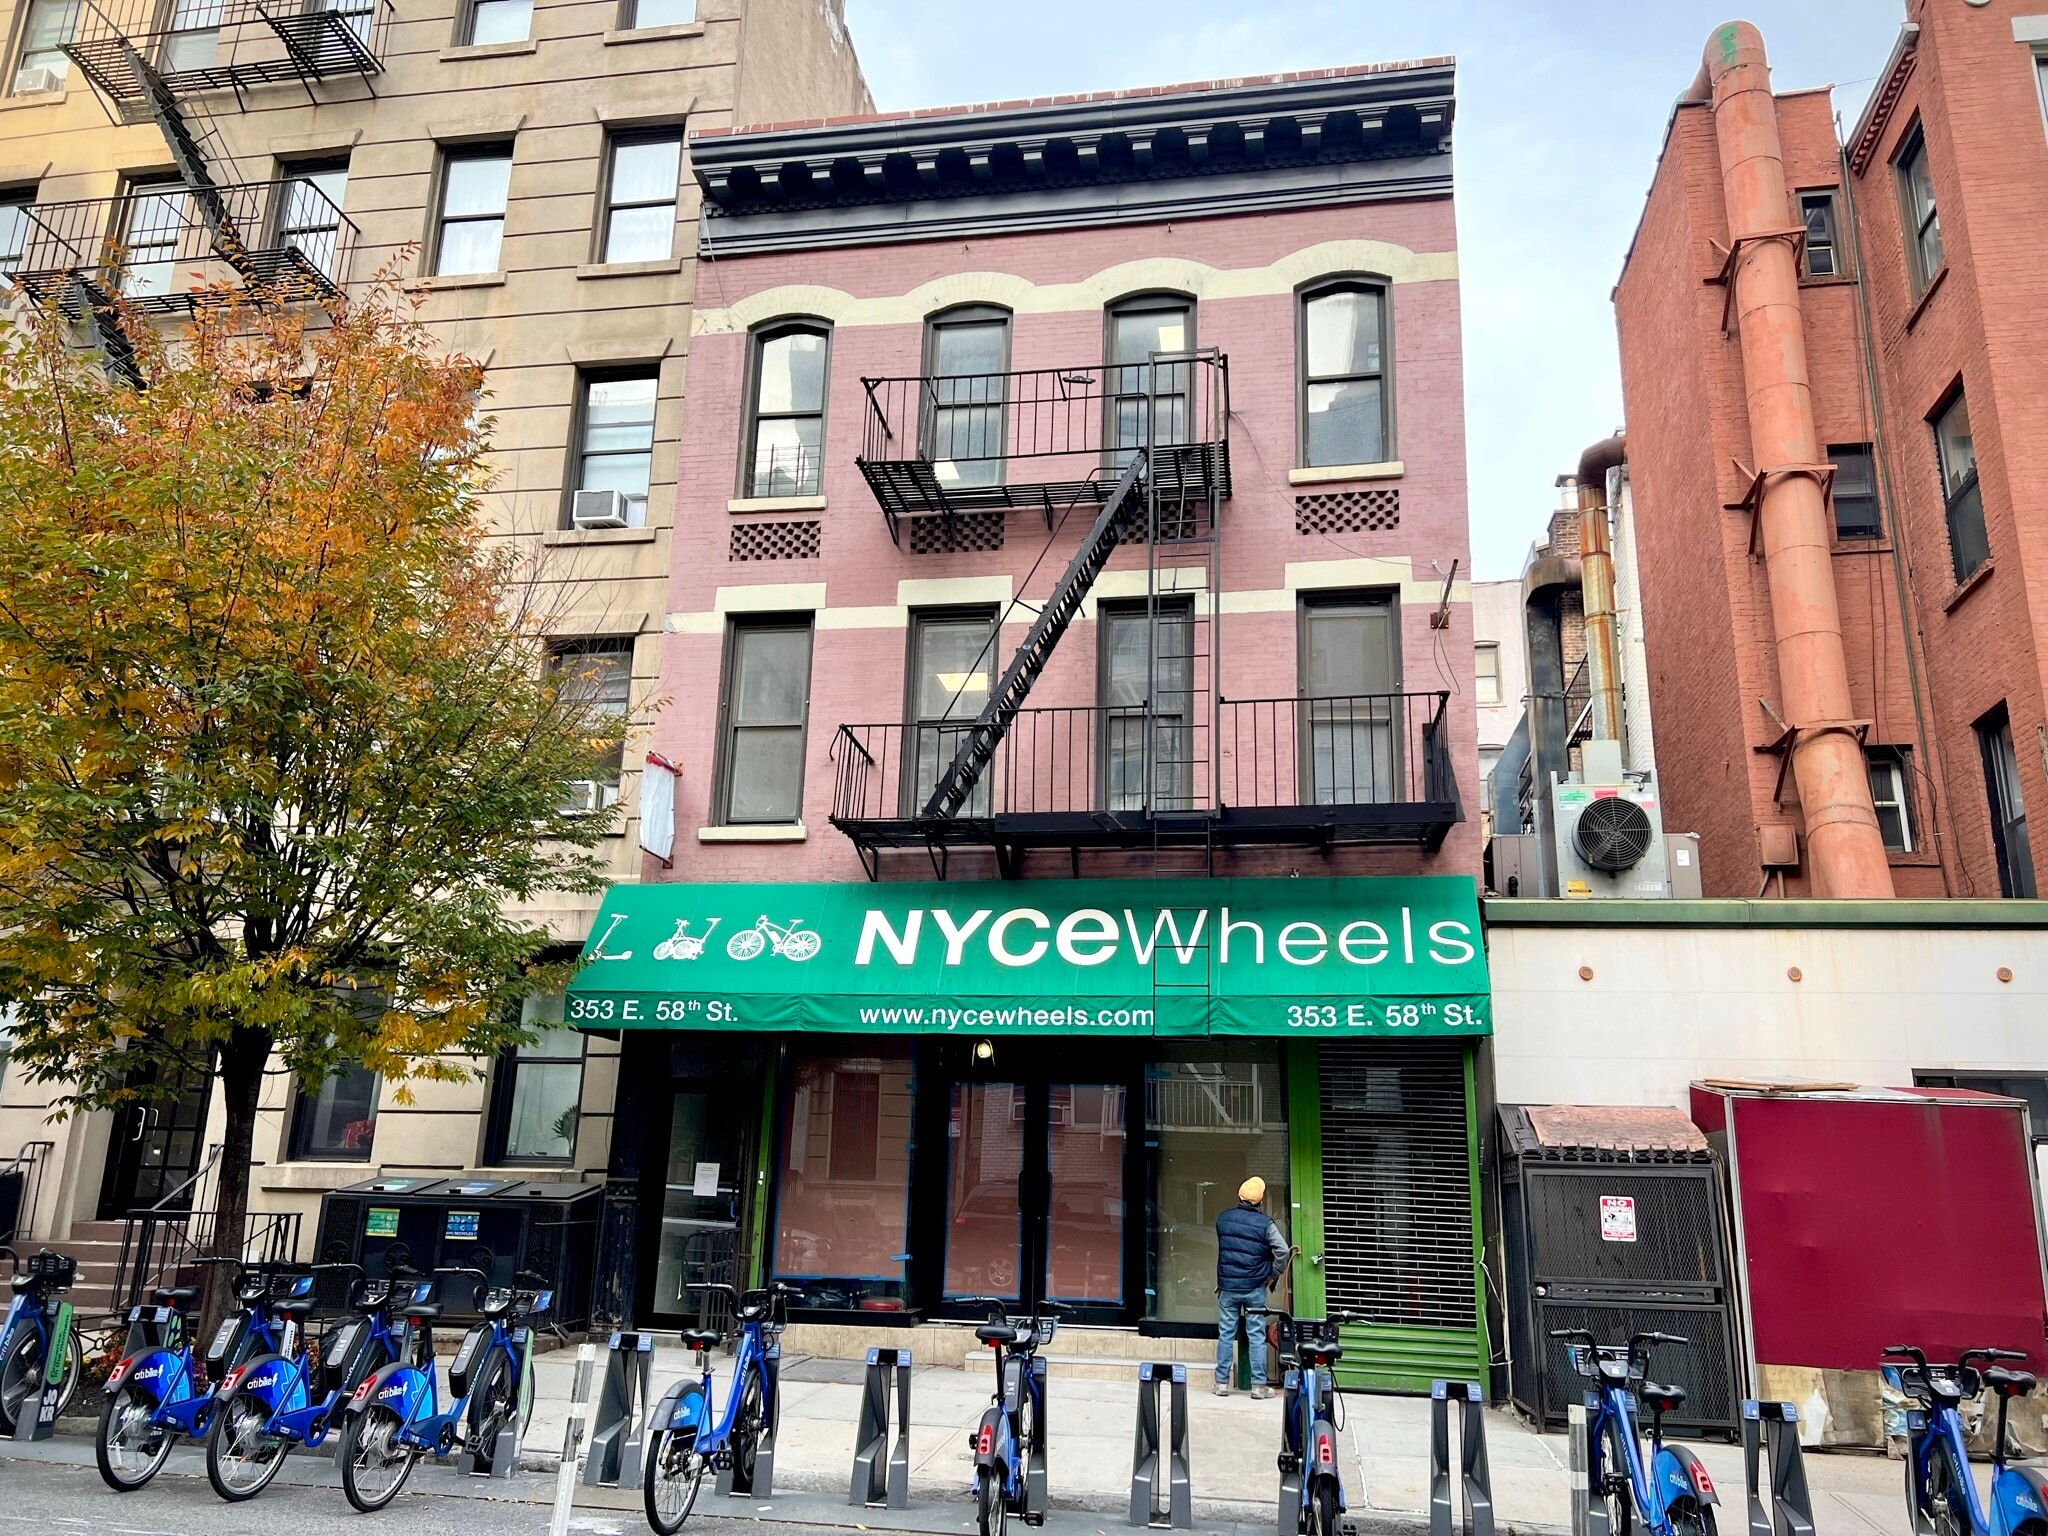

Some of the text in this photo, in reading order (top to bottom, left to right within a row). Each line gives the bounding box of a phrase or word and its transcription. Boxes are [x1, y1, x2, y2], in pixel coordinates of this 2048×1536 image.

[570, 999, 738, 1022] 353 E. 58th St.
[859, 1006, 1154, 1030] www.nycewheels.com
[1287, 1003, 1482, 1027] 353 E. 58th St.
[43, 1389, 58, 1406] JO
[389, 1384, 402, 1397] bike
[39, 1405, 55, 1422] KR
